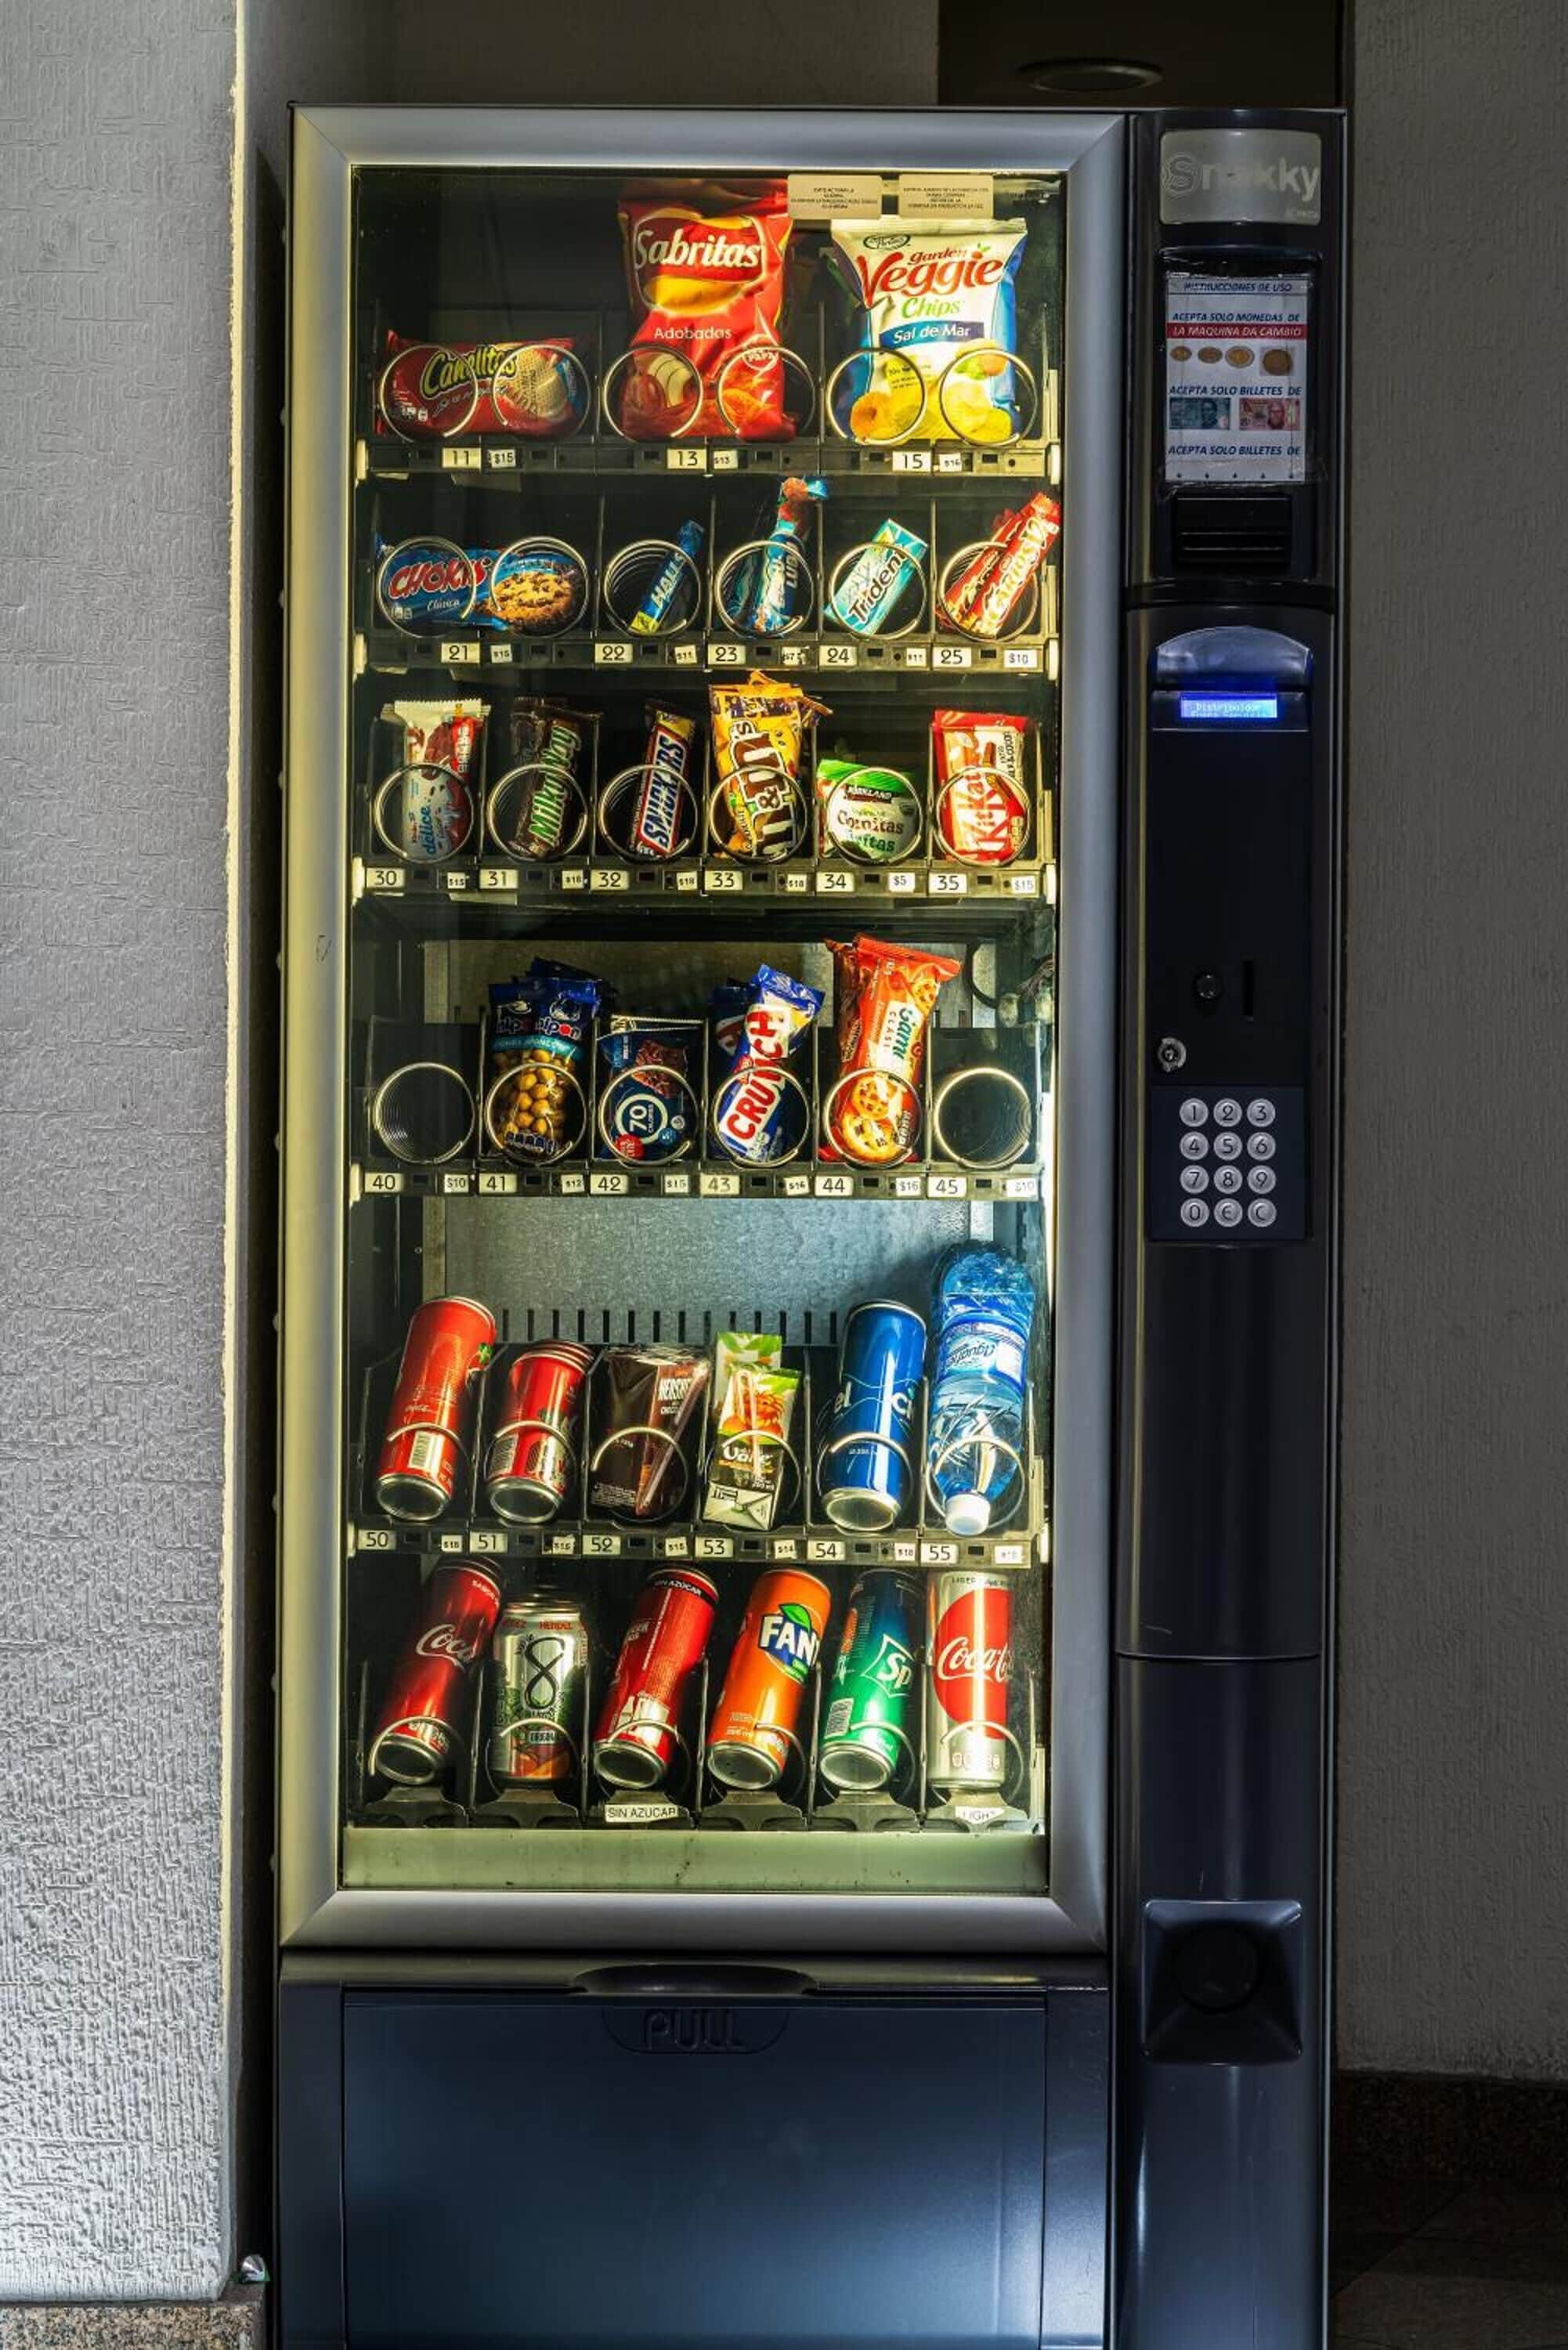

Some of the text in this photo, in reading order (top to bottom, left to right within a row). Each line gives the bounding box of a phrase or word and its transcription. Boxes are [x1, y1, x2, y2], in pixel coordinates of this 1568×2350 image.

[635, 228, 761, 270] Sabritas
[856, 251, 1003, 308] Veggie
[1273, 284, 1292, 292] USO
[901, 296, 963, 320] Chips
[1173, 313, 1301, 322] ACEPTA SOLO MONEDAS DE
[653, 327, 732, 339] Adobadas
[893, 324, 972, 345] Sal de Mar
[1173, 327, 1302, 336] LA MAQUINA DA CAMBIO
[1169, 386, 1302, 396] ACEPTA SOLO BILLETES DE
[453, 451, 470, 465] 11
[494, 452, 514, 464] $15
[677, 450, 698, 466] 13
[1169, 446, 1301, 455] ACEPTA SOLO BILLETES DE
[901, 454, 923, 469] 15
[847, 546, 908, 623] Trident
[448, 645, 470, 660] 21
[602, 645, 625, 661] 22
[714, 646, 739, 662] 23
[826, 647, 850, 663] 24
[940, 648, 963, 664] 25
[1008, 653, 1028, 665] $10
[374, 870, 397, 886] 30
[487, 870, 507, 886] 31
[598, 871, 622, 887] 32
[714, 873, 735, 888] 33
[825, 873, 847, 889] 34
[894, 874, 906, 886] $5
[936, 874, 959, 891] 35
[629, 1104, 648, 1132] 70
[1223, 1104, 1234, 1121] 2
[1255, 1104, 1267, 1121] 3
[1189, 1138, 1200, 1153] 4
[1222, 1138, 1234, 1154] 5
[1255, 1138, 1267, 1154] 6
[372, 1174, 396, 1190] 40
[446, 1177, 466, 1188] $10
[486, 1174, 506, 1191] 41
[597, 1176, 622, 1191] 42
[707, 1175, 732, 1191] 43
[822, 1177, 846, 1192] 44
[935, 1177, 959, 1193] 45
[1189, 1171, 1200, 1186] 7
[1223, 1171, 1234, 1187] 8
[1255, 1171, 1267, 1187] 9
[1190, 1204, 1201, 1221] 0
[1255, 1205, 1266, 1221] C
[366, 1532, 388, 1548] 50
[478, 1534, 497, 1550] 51
[591, 1536, 613, 1552] 52
[703, 1539, 725, 1555] 53
[815, 1542, 837, 1558] 54
[929, 1545, 952, 1560] 55
[608, 1806, 627, 1818] SIN
